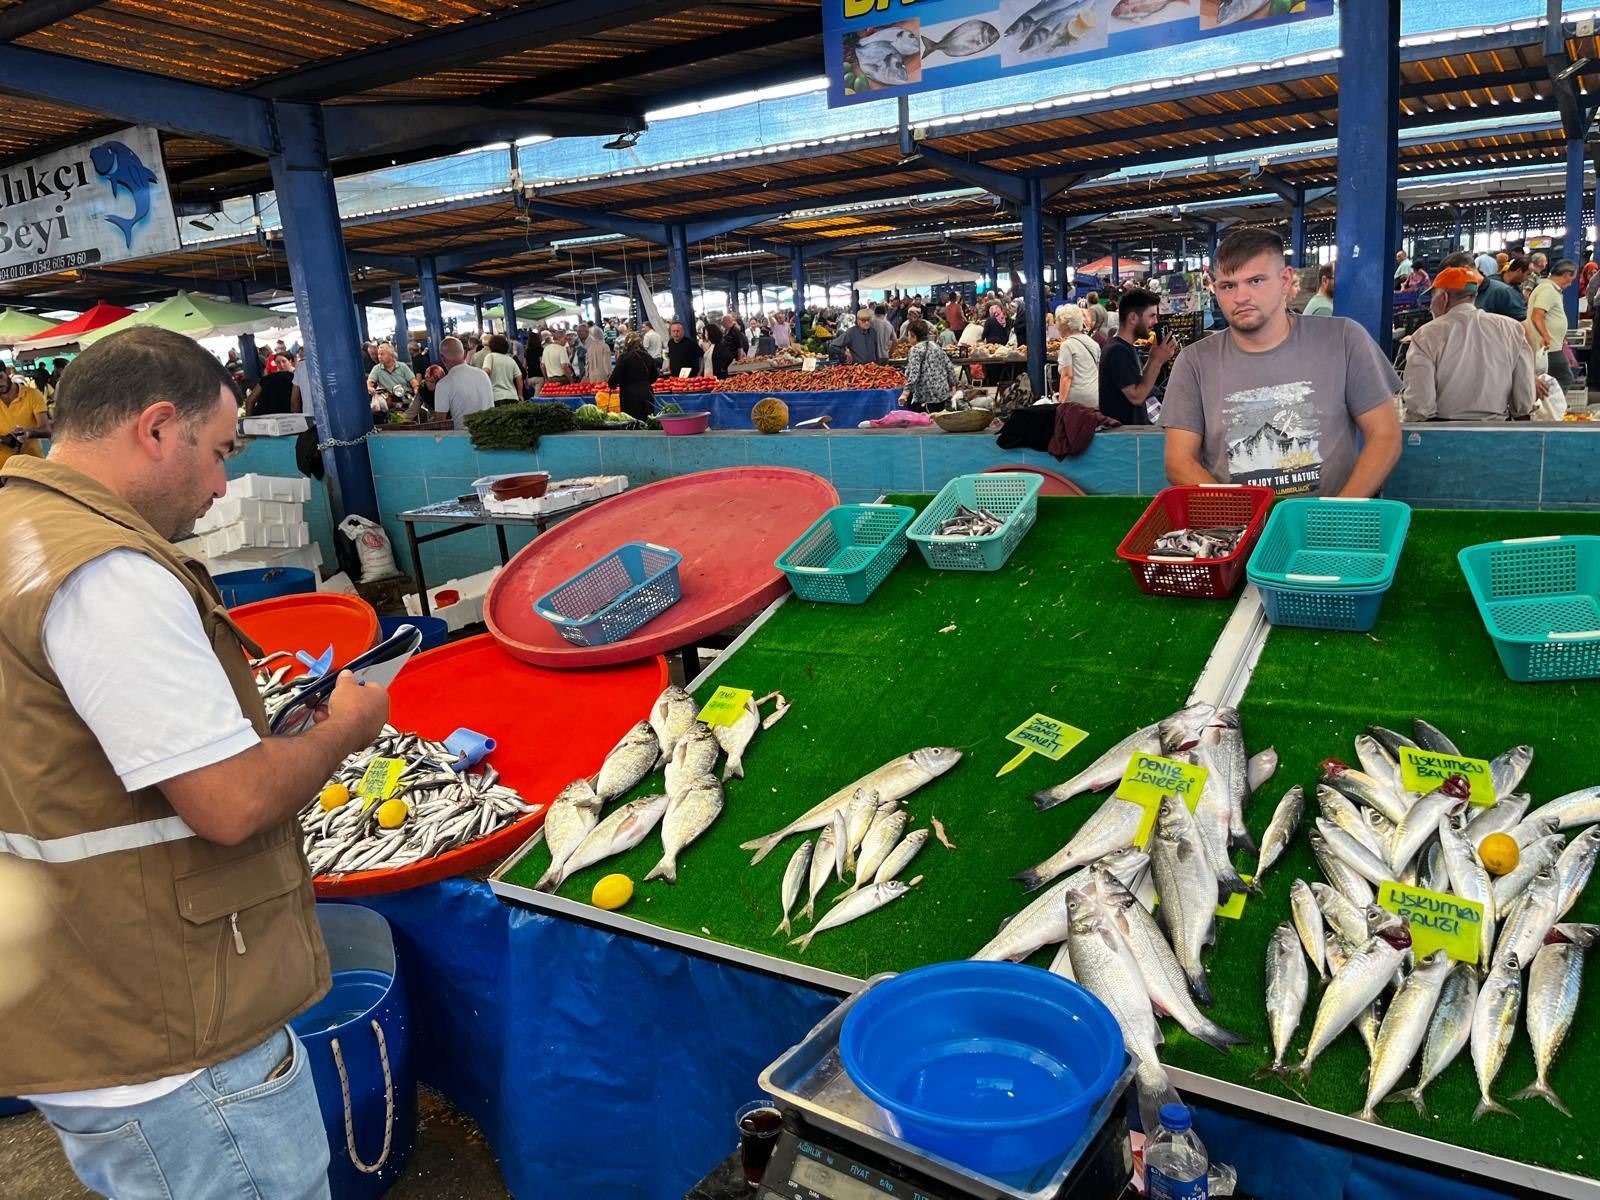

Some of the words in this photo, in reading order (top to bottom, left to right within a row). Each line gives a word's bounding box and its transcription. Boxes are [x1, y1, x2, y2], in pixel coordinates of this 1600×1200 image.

[0, 161, 90, 209] lıkçı
[52, 257, 66, 269] 605
[67, 254, 76, 266] 79
[77, 252, 87, 264] 60
[1247, 477, 1272, 487] ENJOY
[1274, 475, 1290, 486] THE
[1292, 470, 1320, 483] NATURE
